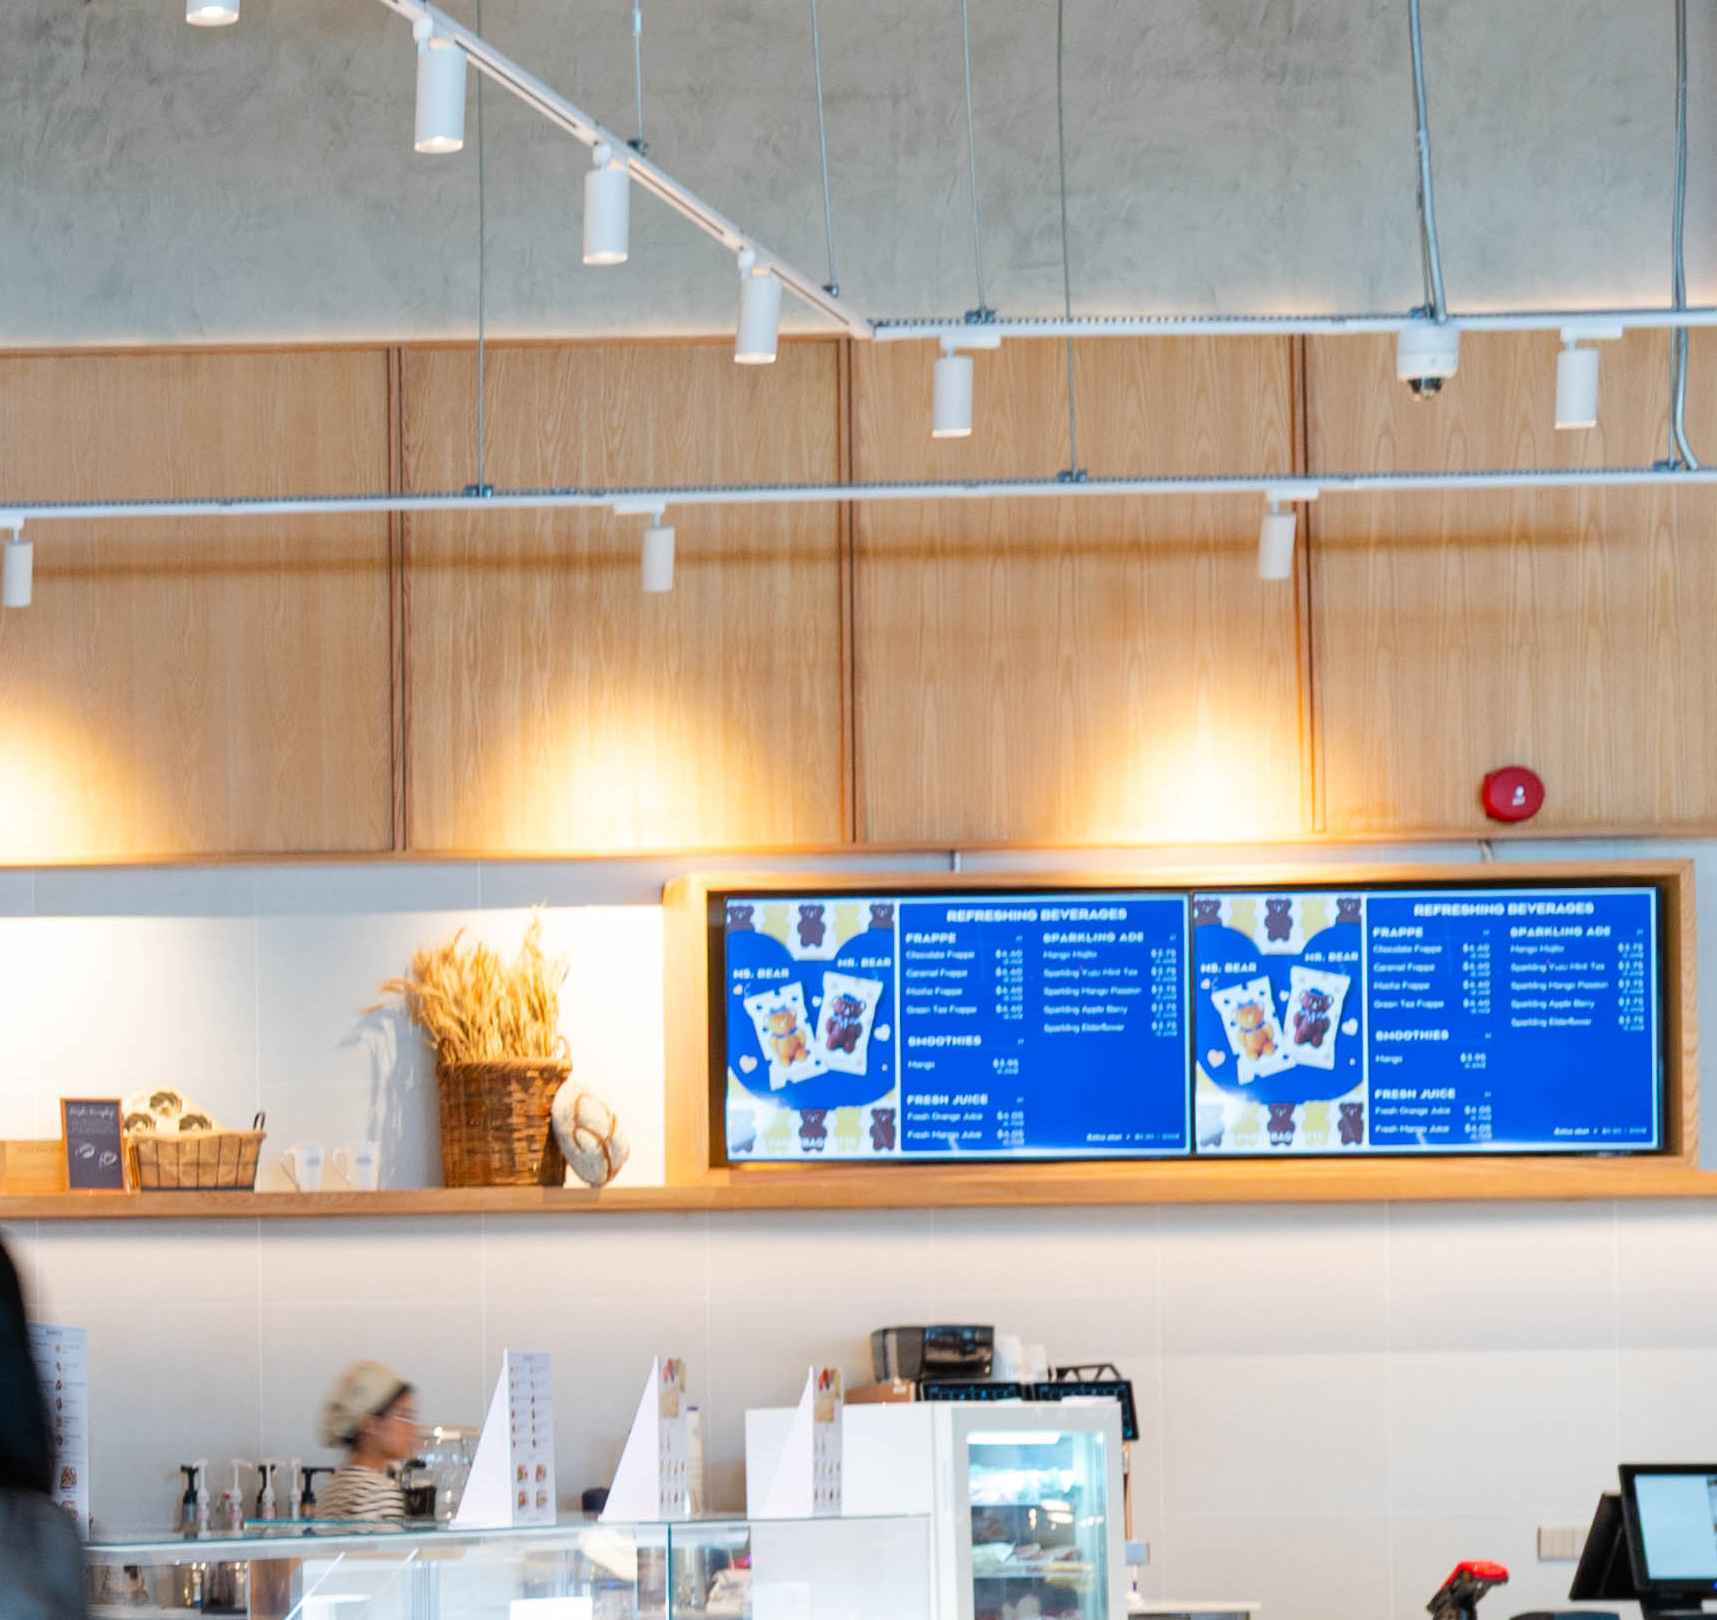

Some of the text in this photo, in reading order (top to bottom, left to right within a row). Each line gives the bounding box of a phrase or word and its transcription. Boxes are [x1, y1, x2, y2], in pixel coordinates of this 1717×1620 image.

[947, 908, 1127, 922] REFRESHING BEVERAGES
[1414, 902, 1594, 917] REFRESHING BEVERAGES
[1043, 931, 1144, 944] SPARKLING ADE
[1510, 926, 1611, 938] SPARKLING ADE
[861, 957, 892, 968] BEAR
[1328, 952, 1359, 962] BEAR
[757, 968, 789, 979] BEAR
[1224, 962, 1257, 973] BEAR
[907, 1035, 982, 1047] SMOOTHIES
[1375, 1029, 1450, 1042] SMOOTHIES
[907, 1093, 988, 1106] FRESH JUICE
[1374, 1088, 1456, 1100] FRESH JUICE
